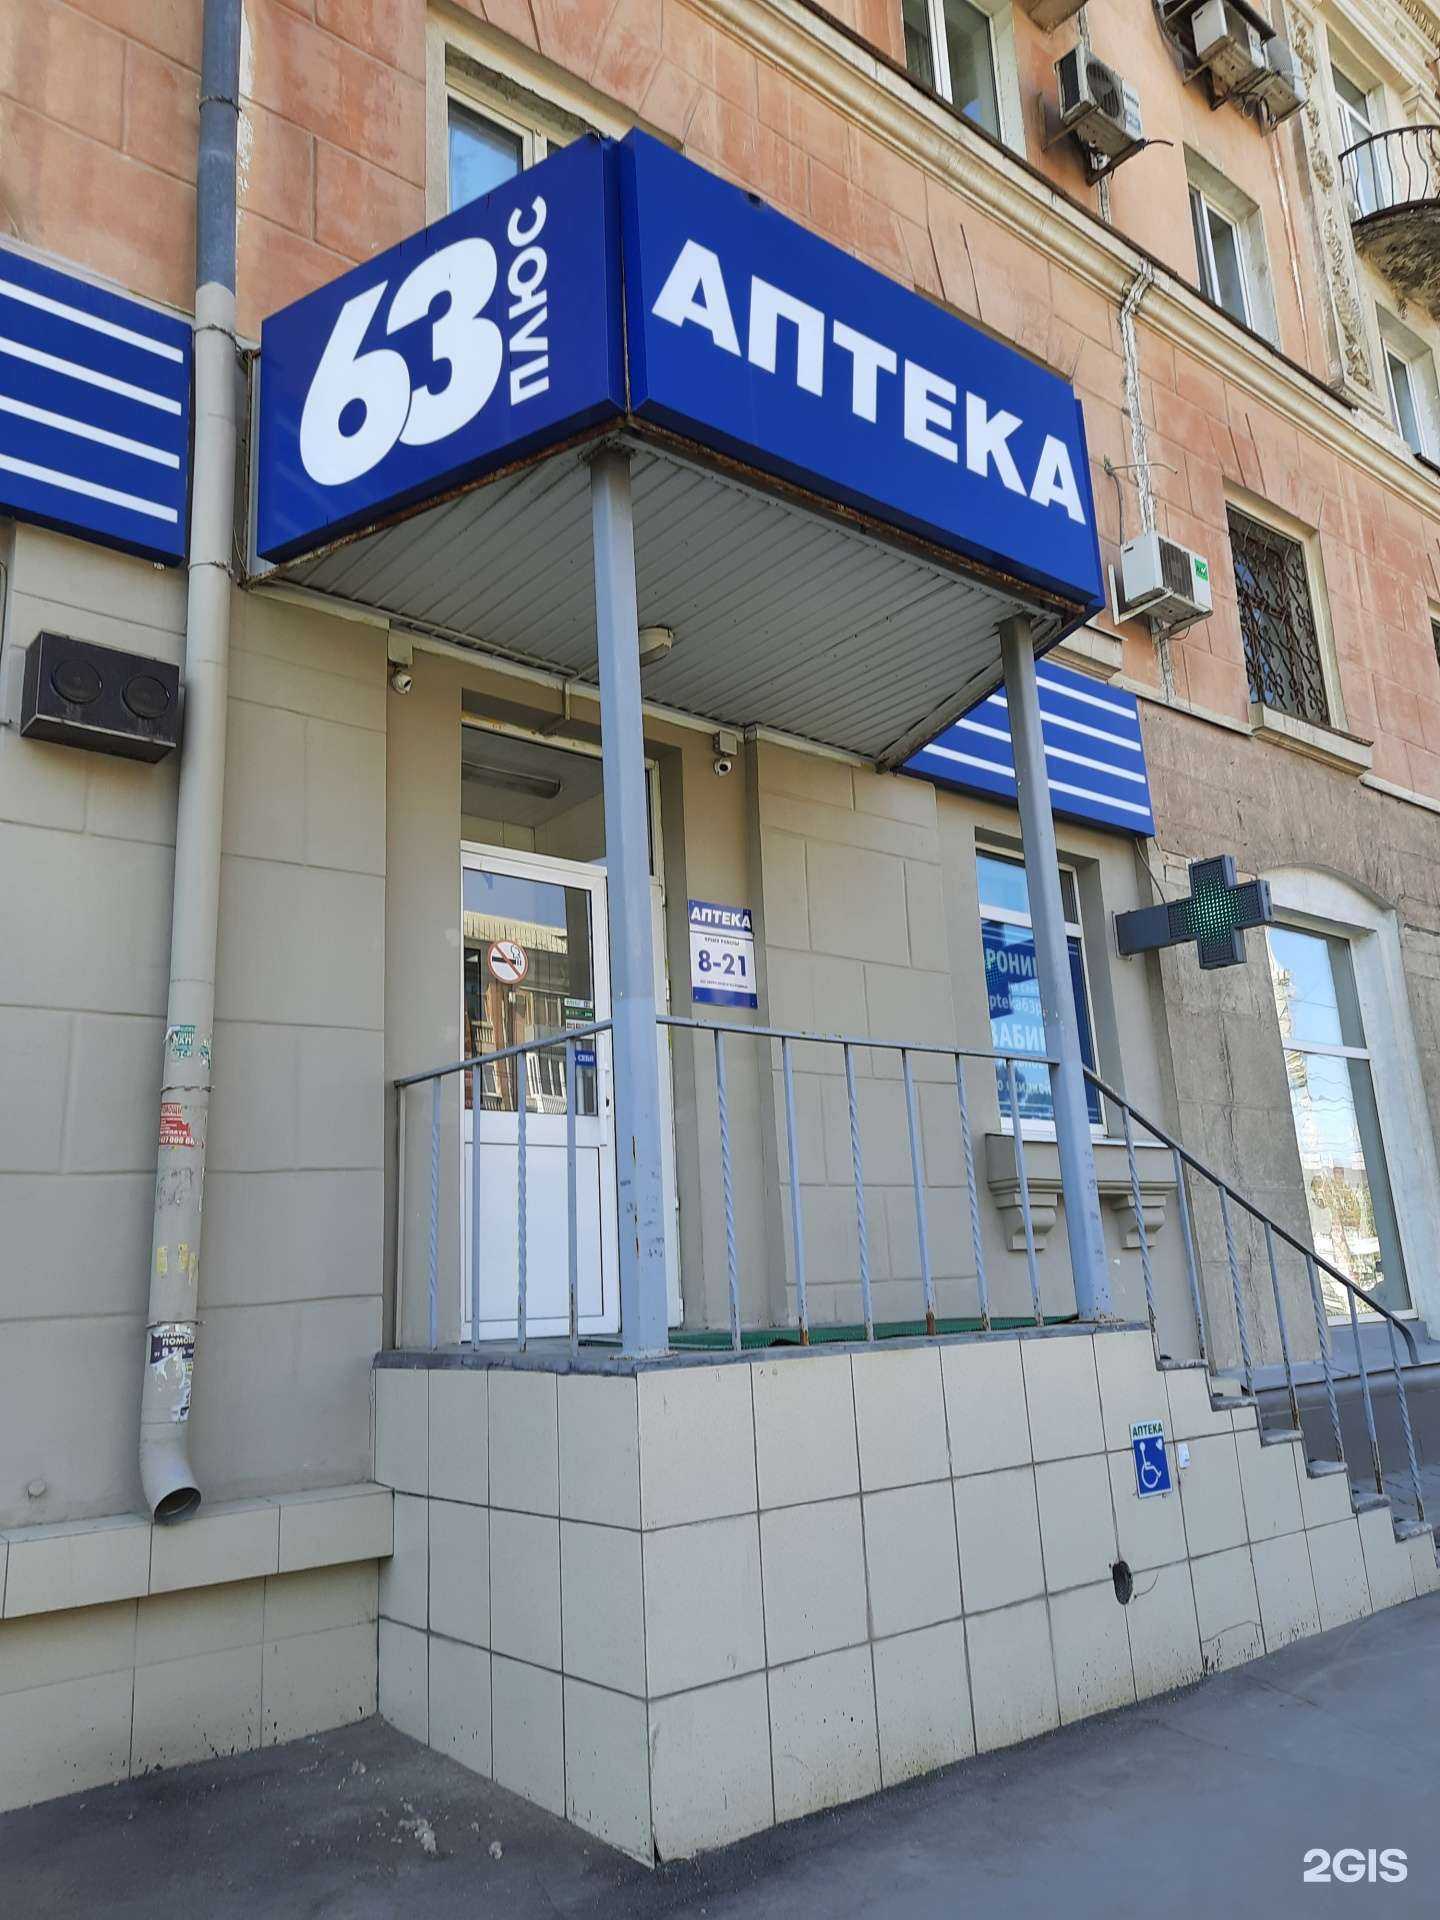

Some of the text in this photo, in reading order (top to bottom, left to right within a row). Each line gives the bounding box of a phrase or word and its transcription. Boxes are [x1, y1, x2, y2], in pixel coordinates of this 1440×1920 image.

[507, 195, 550, 406] ПЛЮС
[298, 236, 504, 488] 63
[652, 238, 1087, 526] АПТЕКА
[691, 906, 751, 929] АПТЕКА
[698, 949, 747, 977] 8-21
[1132, 1422, 1163, 1437] АПТЕКА
